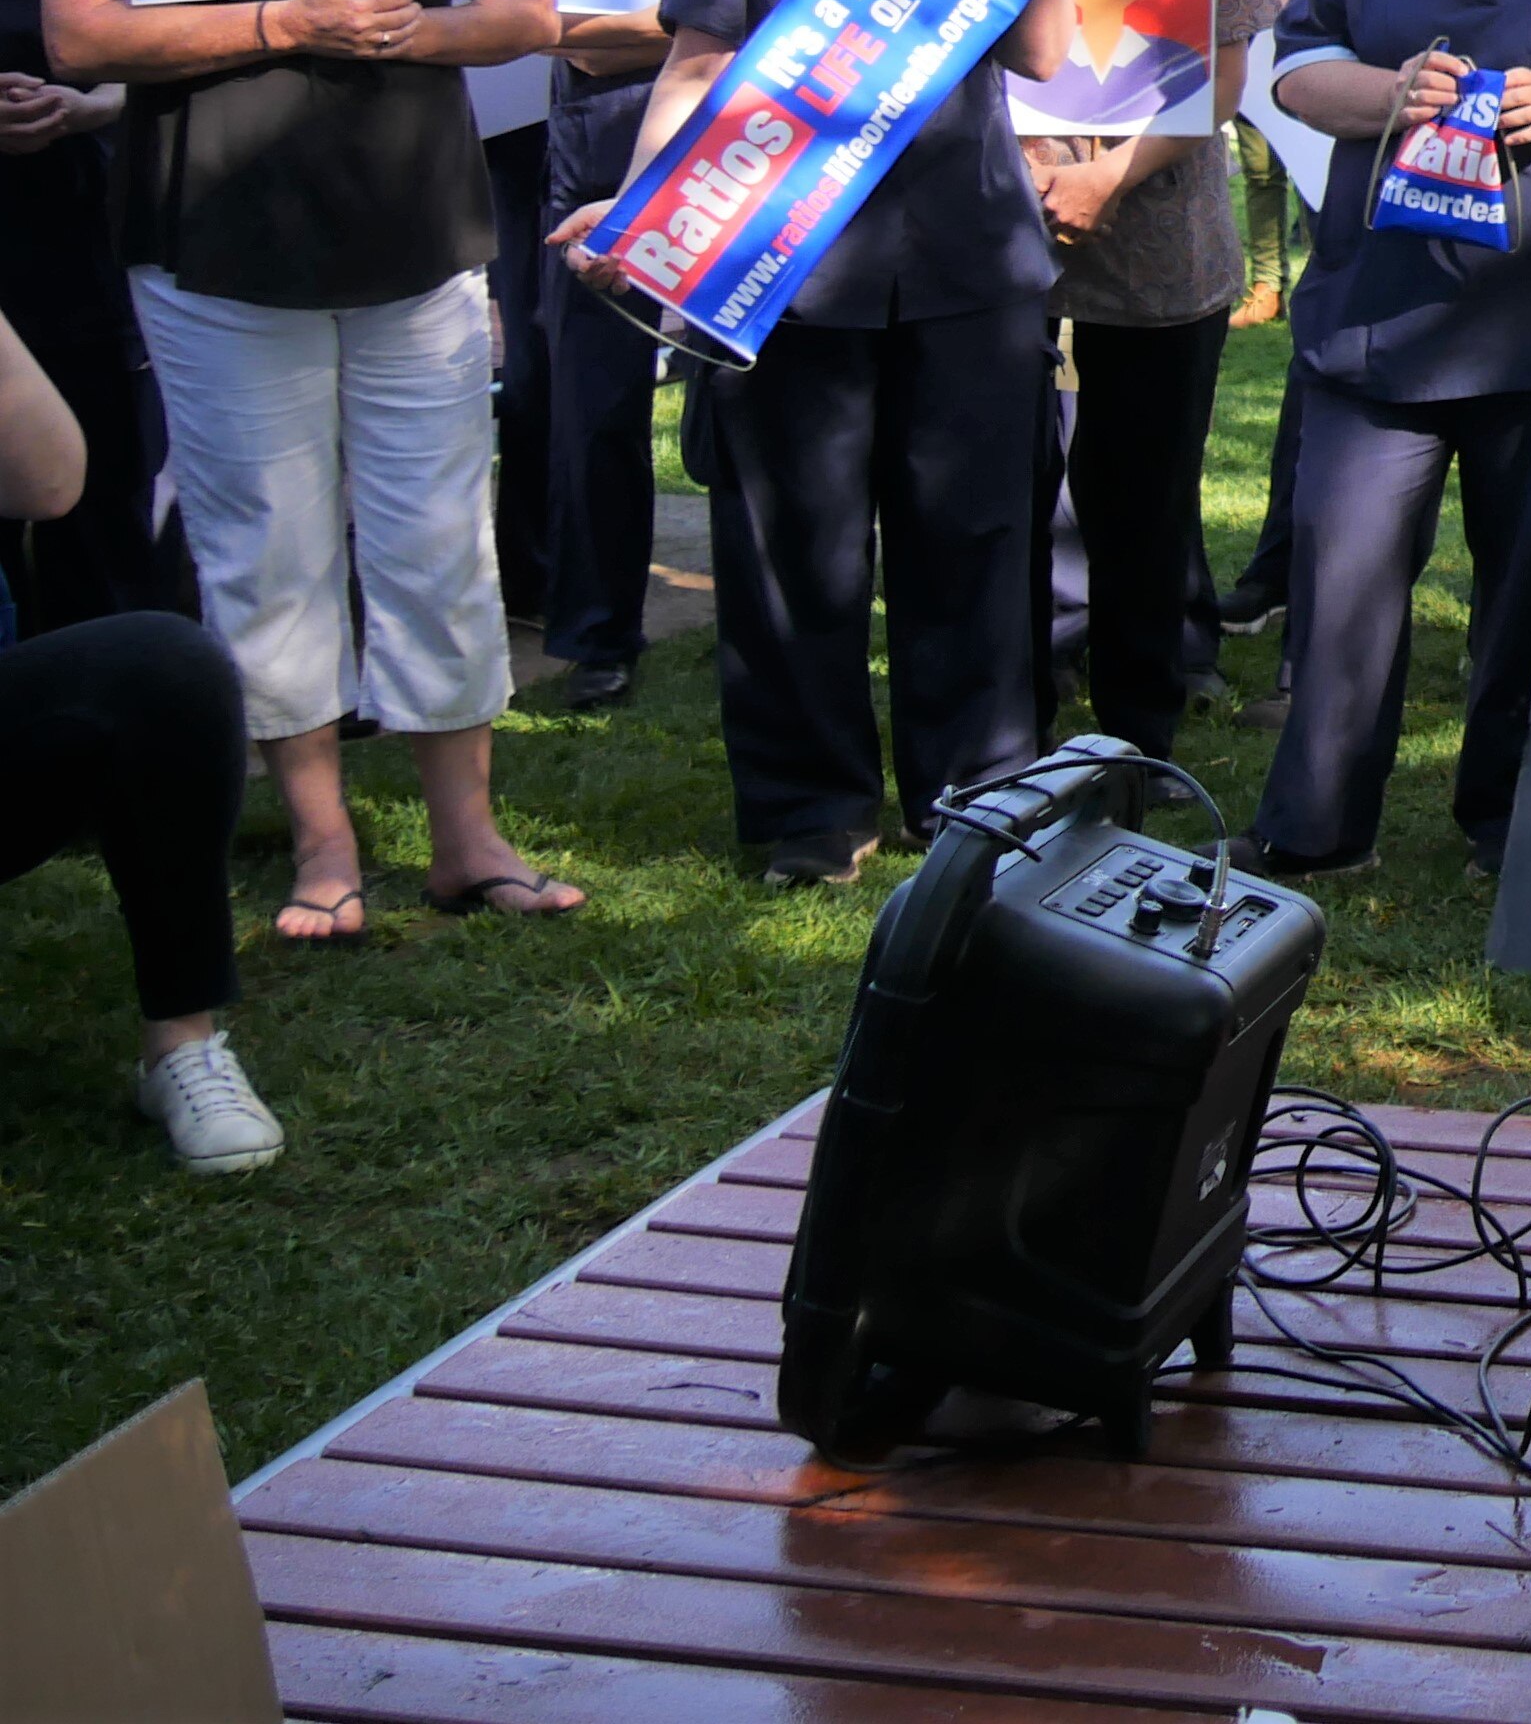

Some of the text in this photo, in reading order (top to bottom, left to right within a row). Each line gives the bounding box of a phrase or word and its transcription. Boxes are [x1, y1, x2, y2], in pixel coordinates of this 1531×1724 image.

[757, 24, 826, 89] It's
[795, 23, 887, 118] LIFE
[622, 109, 795, 291] Ratios
